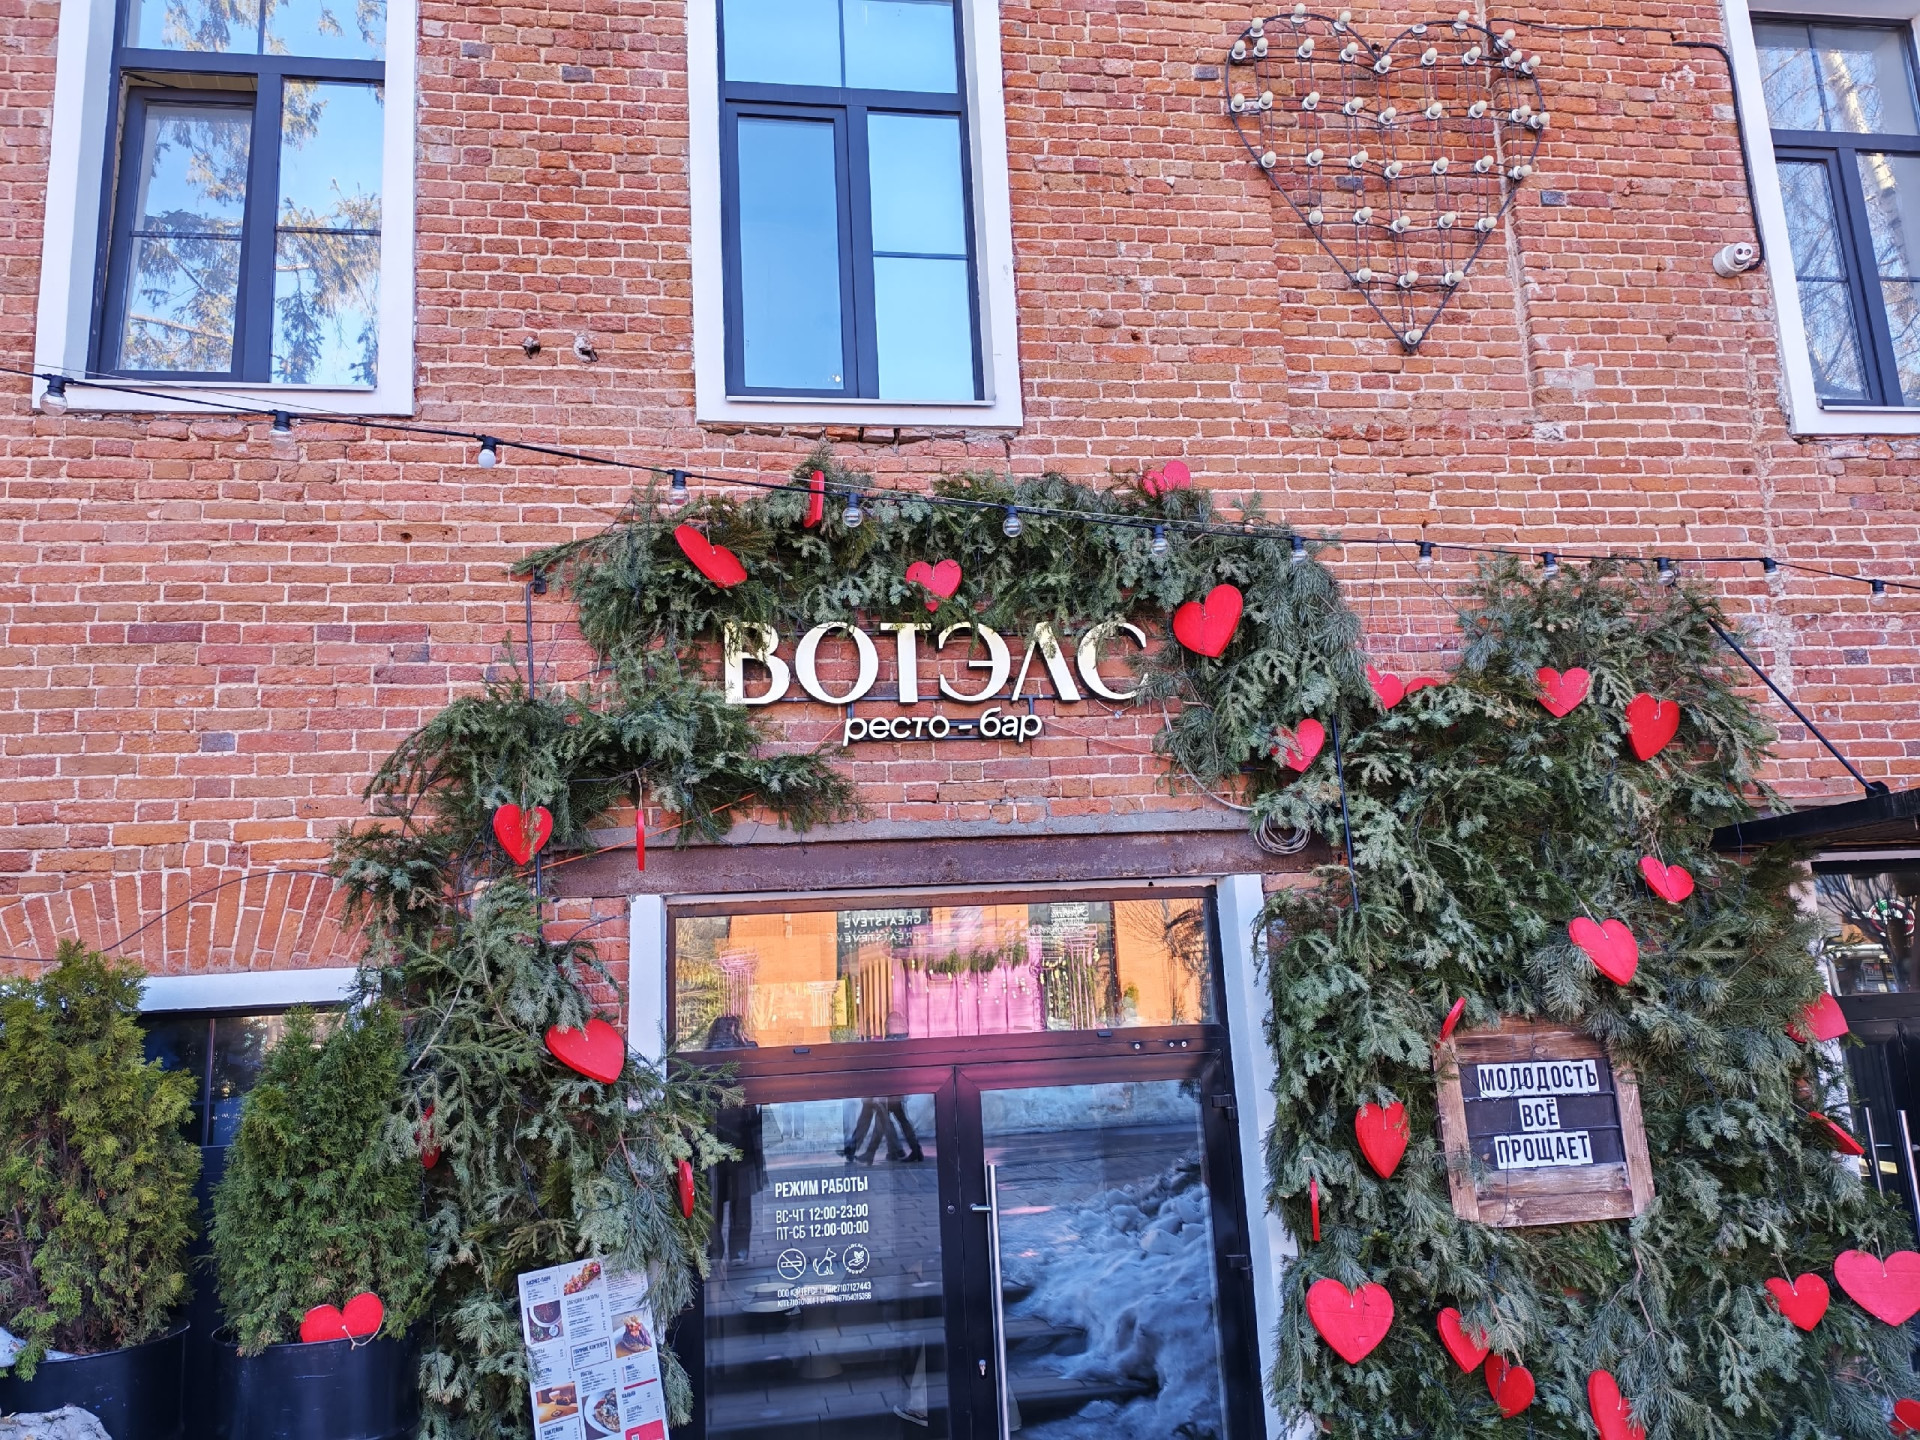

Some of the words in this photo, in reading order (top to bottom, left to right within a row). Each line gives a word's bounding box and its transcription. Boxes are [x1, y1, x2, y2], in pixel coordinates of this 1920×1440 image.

[724, 621, 1148, 704] ВОТЭЛС
[1479, 1064, 1597, 1092] МОЛОДОСТЬ
[1521, 1099, 1558, 1127] ВСЁ
[1497, 1135, 1588, 1163] ПРОЩАЕТ
[775, 1180, 818, 1198] РЕЖИМ
[821, 1176, 868, 1194] РАБОТЫ
[776, 1208, 806, 1224] ВС-ЧТ
[809, 1203, 868, 1221] 12:00-23:00
[776, 1225, 806, 1241] ПТ-СБ
[809, 1219, 869, 1238] 12:00-00:00
